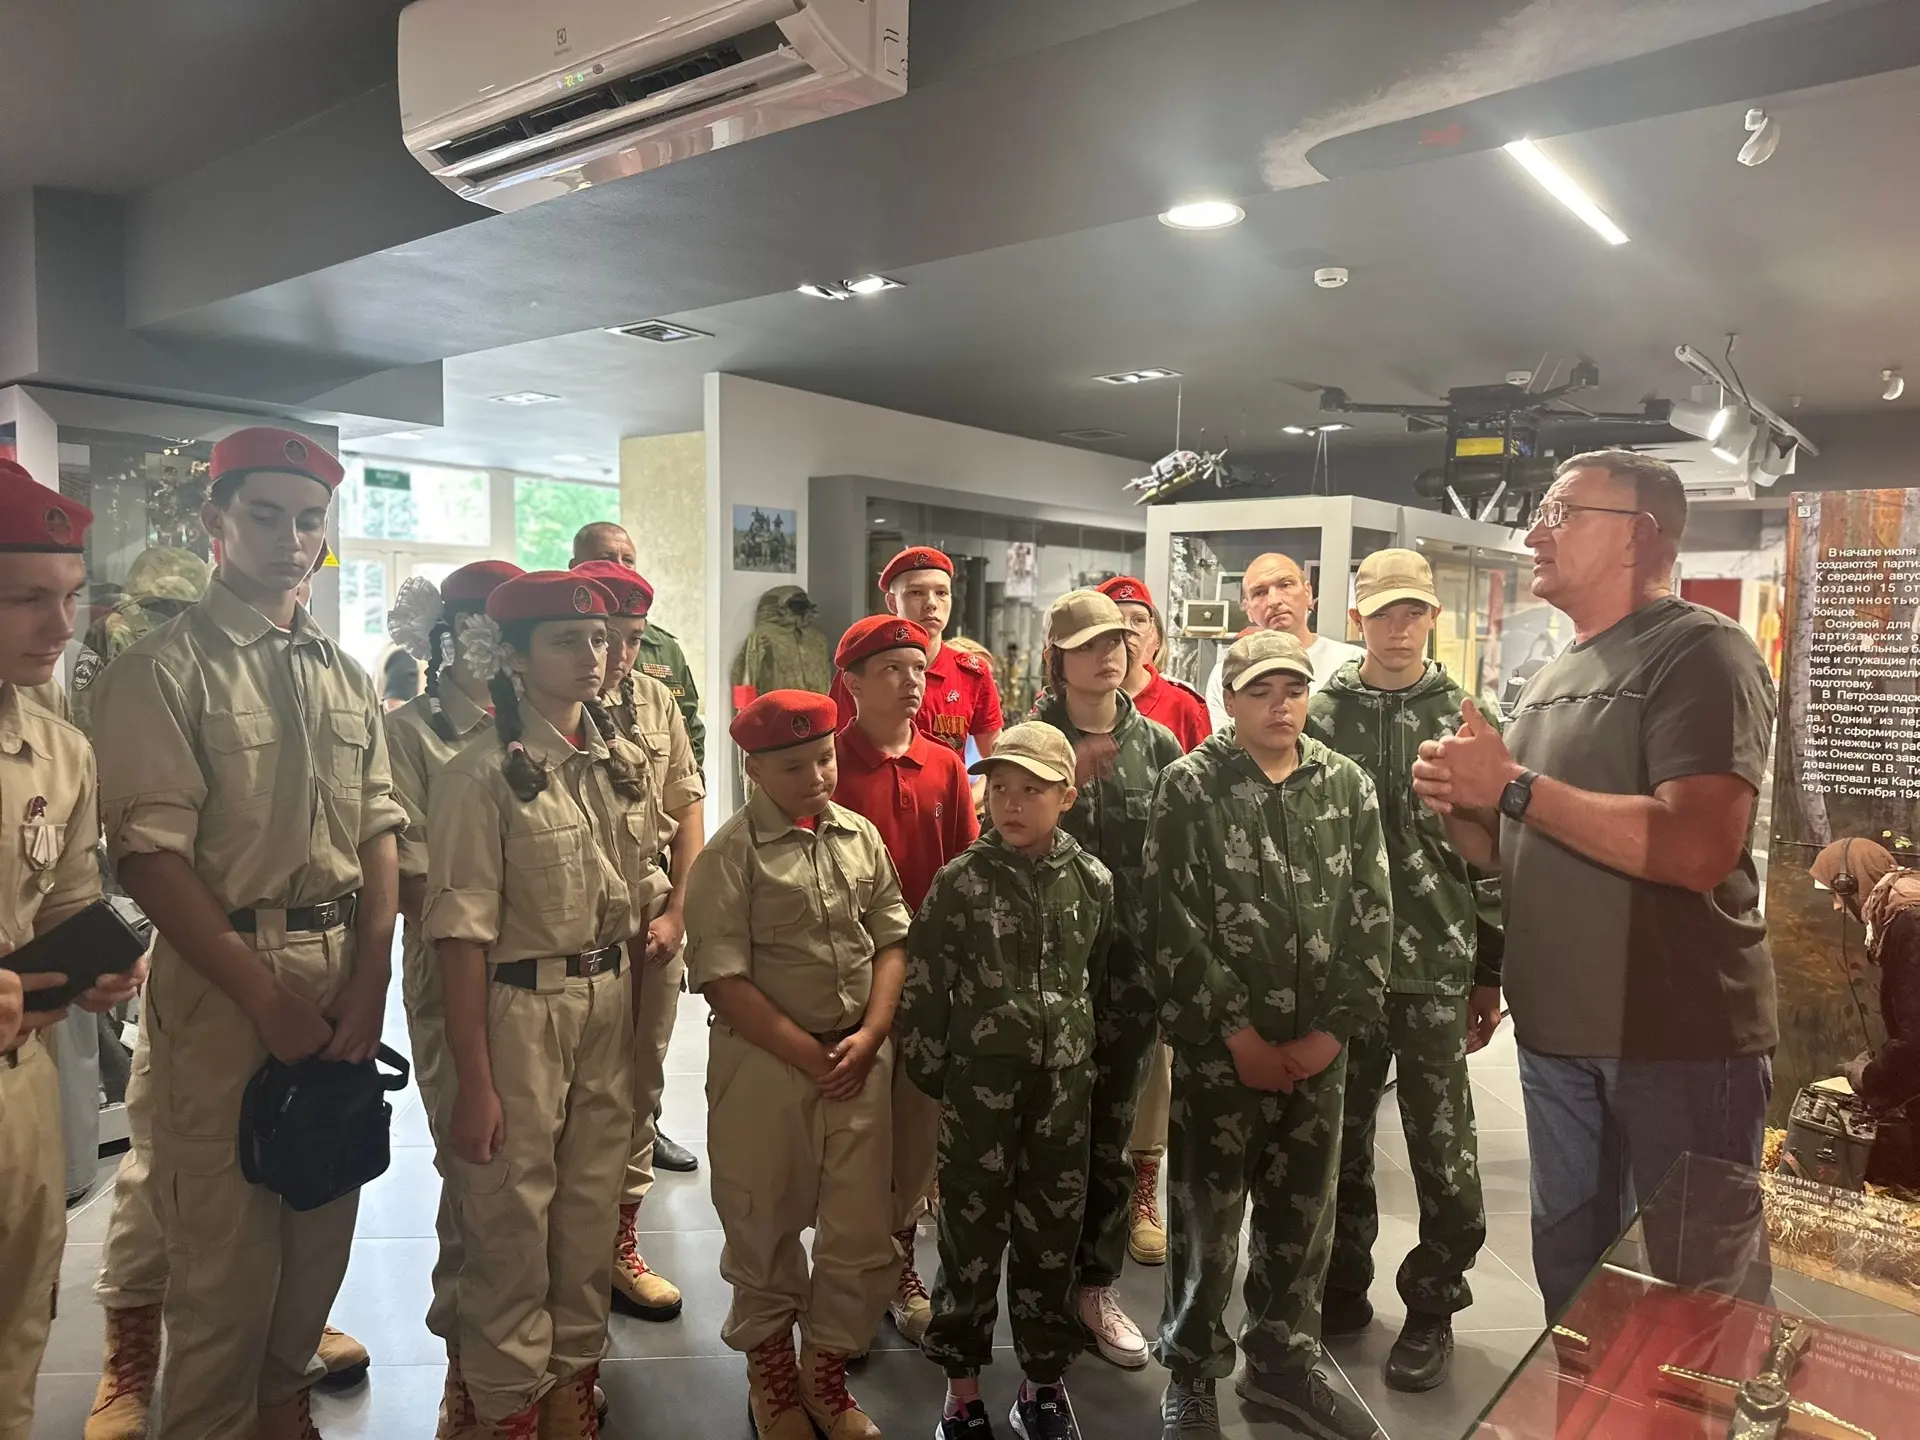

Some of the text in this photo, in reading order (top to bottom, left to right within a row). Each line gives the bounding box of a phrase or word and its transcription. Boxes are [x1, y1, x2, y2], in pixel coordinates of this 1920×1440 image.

[1828, 547, 1916, 557] В начале июля
[1815, 561, 1878, 570] создаются
[1815, 572, 1823, 580] К
[1827, 572, 1884, 582] середине
[1814, 585, 1871, 594] создано
[1880, 583, 1896, 593] 15
[1813, 596, 1919, 605] численностью
[1812, 606, 1858, 617] бойцов.
[1825, 619, 1911, 631] Основой для
[1811, 632, 1903, 642] партизанских
[1810, 642, 1909, 653] истребительные
[1810, 655, 1831, 664] чие
[1833, 656, 1841, 664] и
[1843, 655, 1906, 666] служащие
[1809, 665, 1852, 677] работы
[1808, 679, 1874, 691] подготовку.
[1822, 690, 1830, 699] В
[1806, 703, 1865, 713] мировано
[1868, 705, 1889, 714] три
[1805, 714, 1824, 723] да.
[1831, 713, 1872, 724] Одним
[1880, 717, 1893, 726] из
[1806, 725, 1833, 734] 1941
[1835, 727, 1842, 735] г.
[1804, 735, 1828, 745] ный
[1830, 738, 1882, 750] онежец»
[1885, 741, 1899, 750] из
[1803, 749, 1828, 759] щих
[1829, 748, 1894, 761] Онежского
[1802, 760, 1864, 771] дованием
[1872, 763, 1898, 774] В.В.
[1801, 771, 1871, 784] действовал
[1873, 777, 1888, 786] на
[1801, 783, 1815, 791] те
[1815, 784, 1831, 793] до
[1833, 784, 1847, 794] 15
[1848, 787, 1896, 799] октября
